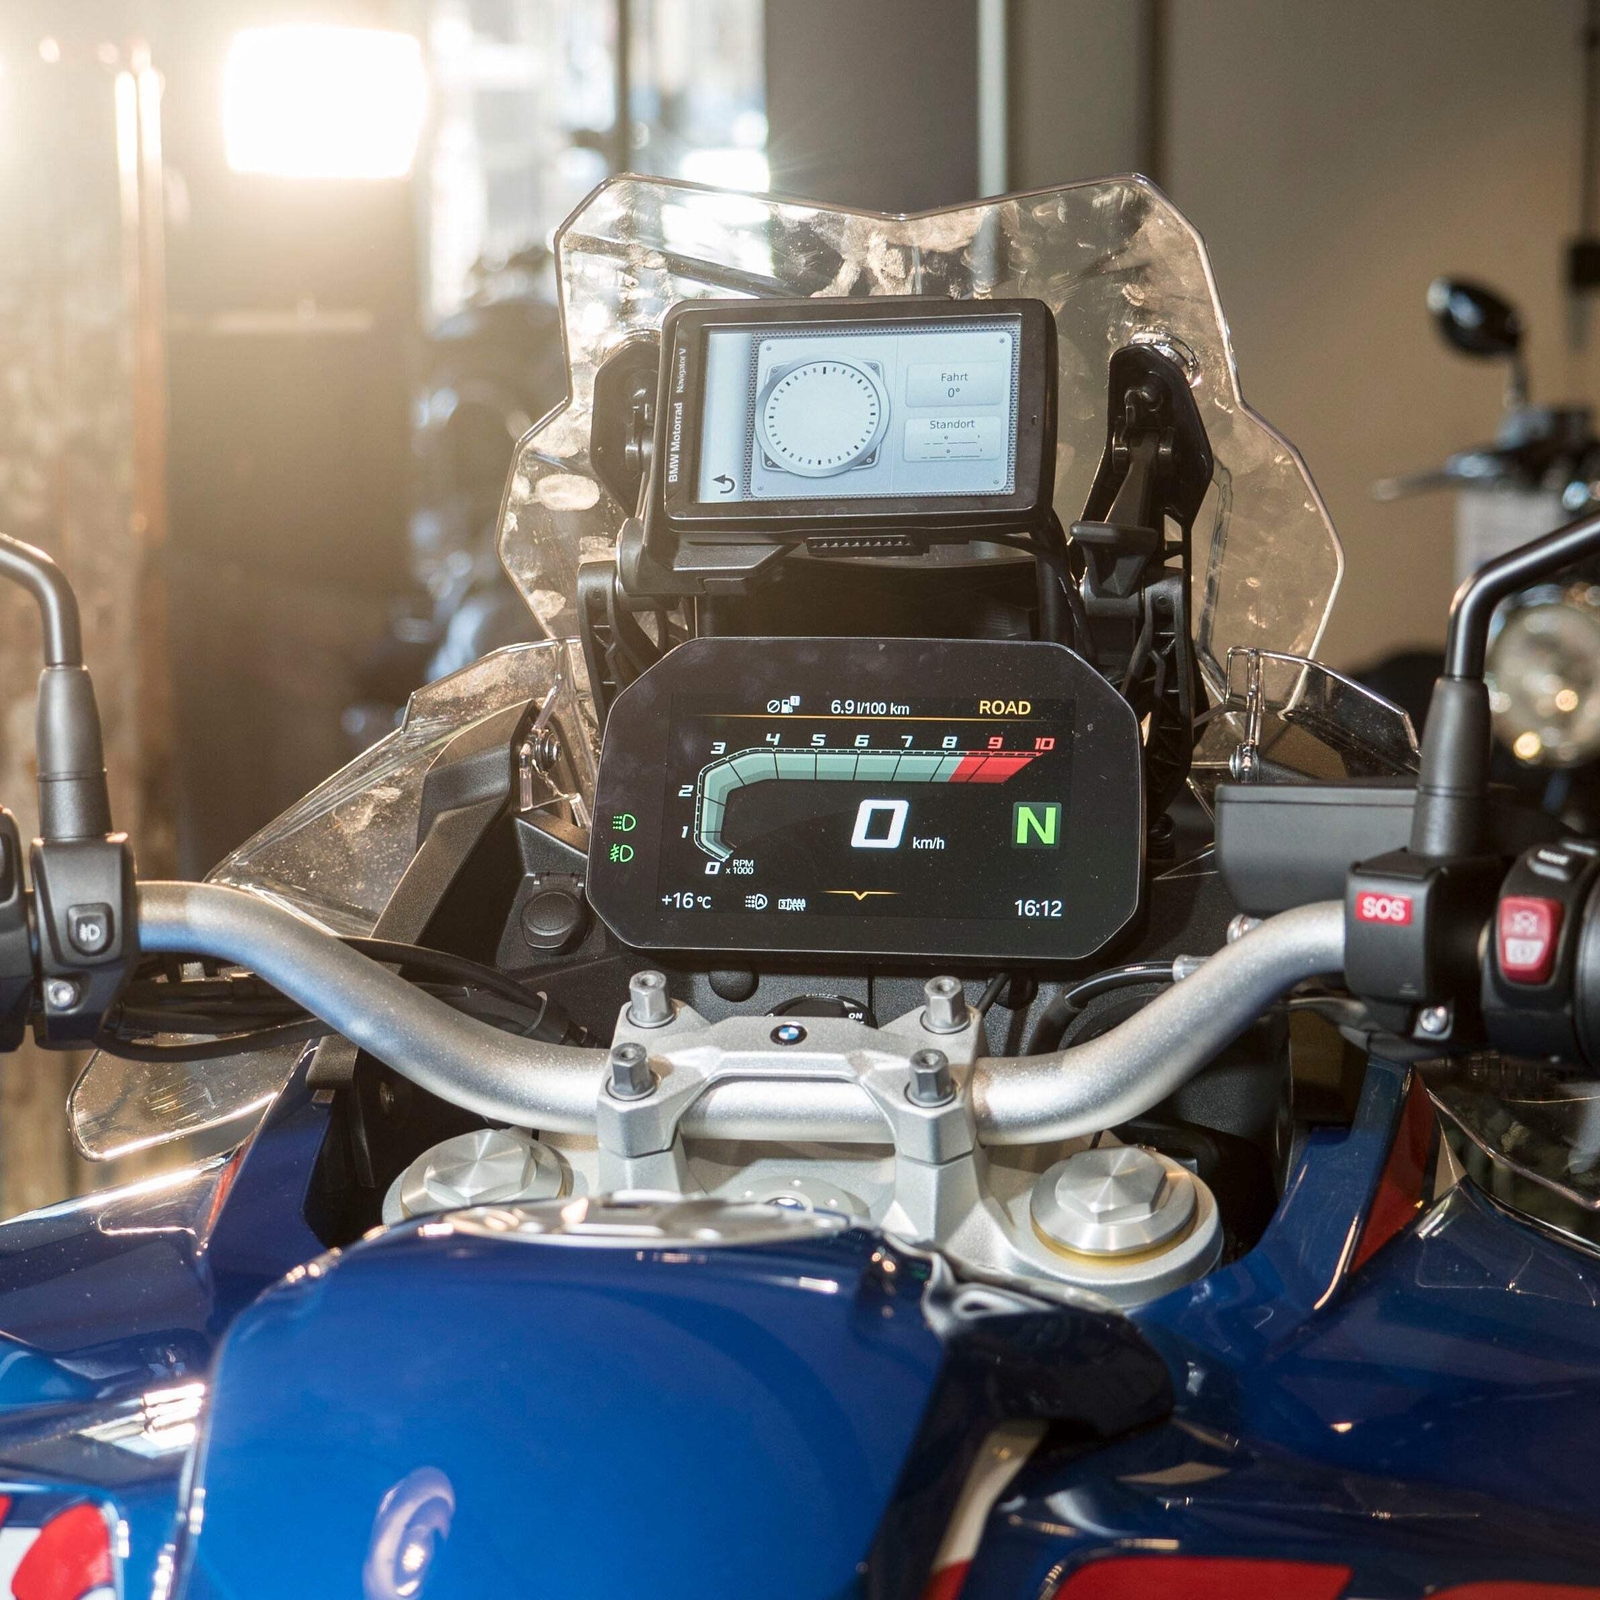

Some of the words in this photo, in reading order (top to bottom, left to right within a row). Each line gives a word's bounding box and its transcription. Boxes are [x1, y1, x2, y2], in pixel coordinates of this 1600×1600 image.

[676, 357, 687, 394] Navigator
[941, 372, 969, 382] Fahrt
[947, 387, 960, 398] 0°
[671, 402, 683, 451] Motorrad
[930, 420, 975, 430] Standort
[669, 453, 680, 483] BMW
[831, 699, 855, 714] 6.9
[857, 702, 887, 715] l/100
[890, 702, 910, 715] km
[979, 700, 1031, 715] ROAD
[710, 742, 726, 754] 3
[766, 733, 781, 745] 4
[810, 734, 826, 746] 5
[854, 734, 870, 747] 6
[901, 735, 913, 748] 7
[942, 736, 958, 749] 8
[987, 737, 1004, 749] 9
[1035, 738, 1055, 750] 10
[678, 784, 694, 797] 2
[851, 799, 910, 849] 0
[1016, 806, 1057, 845] N
[681, 826, 689, 838] 1
[912, 836, 945, 849] km/h
[705, 861, 720, 874] 0
[733, 859, 754, 867] RPM
[732, 867, 754, 875] 1000
[1014, 899, 1063, 917] 16:12
[1362, 896, 1405, 921] SOS
[848, 1012, 863, 1020] ON
